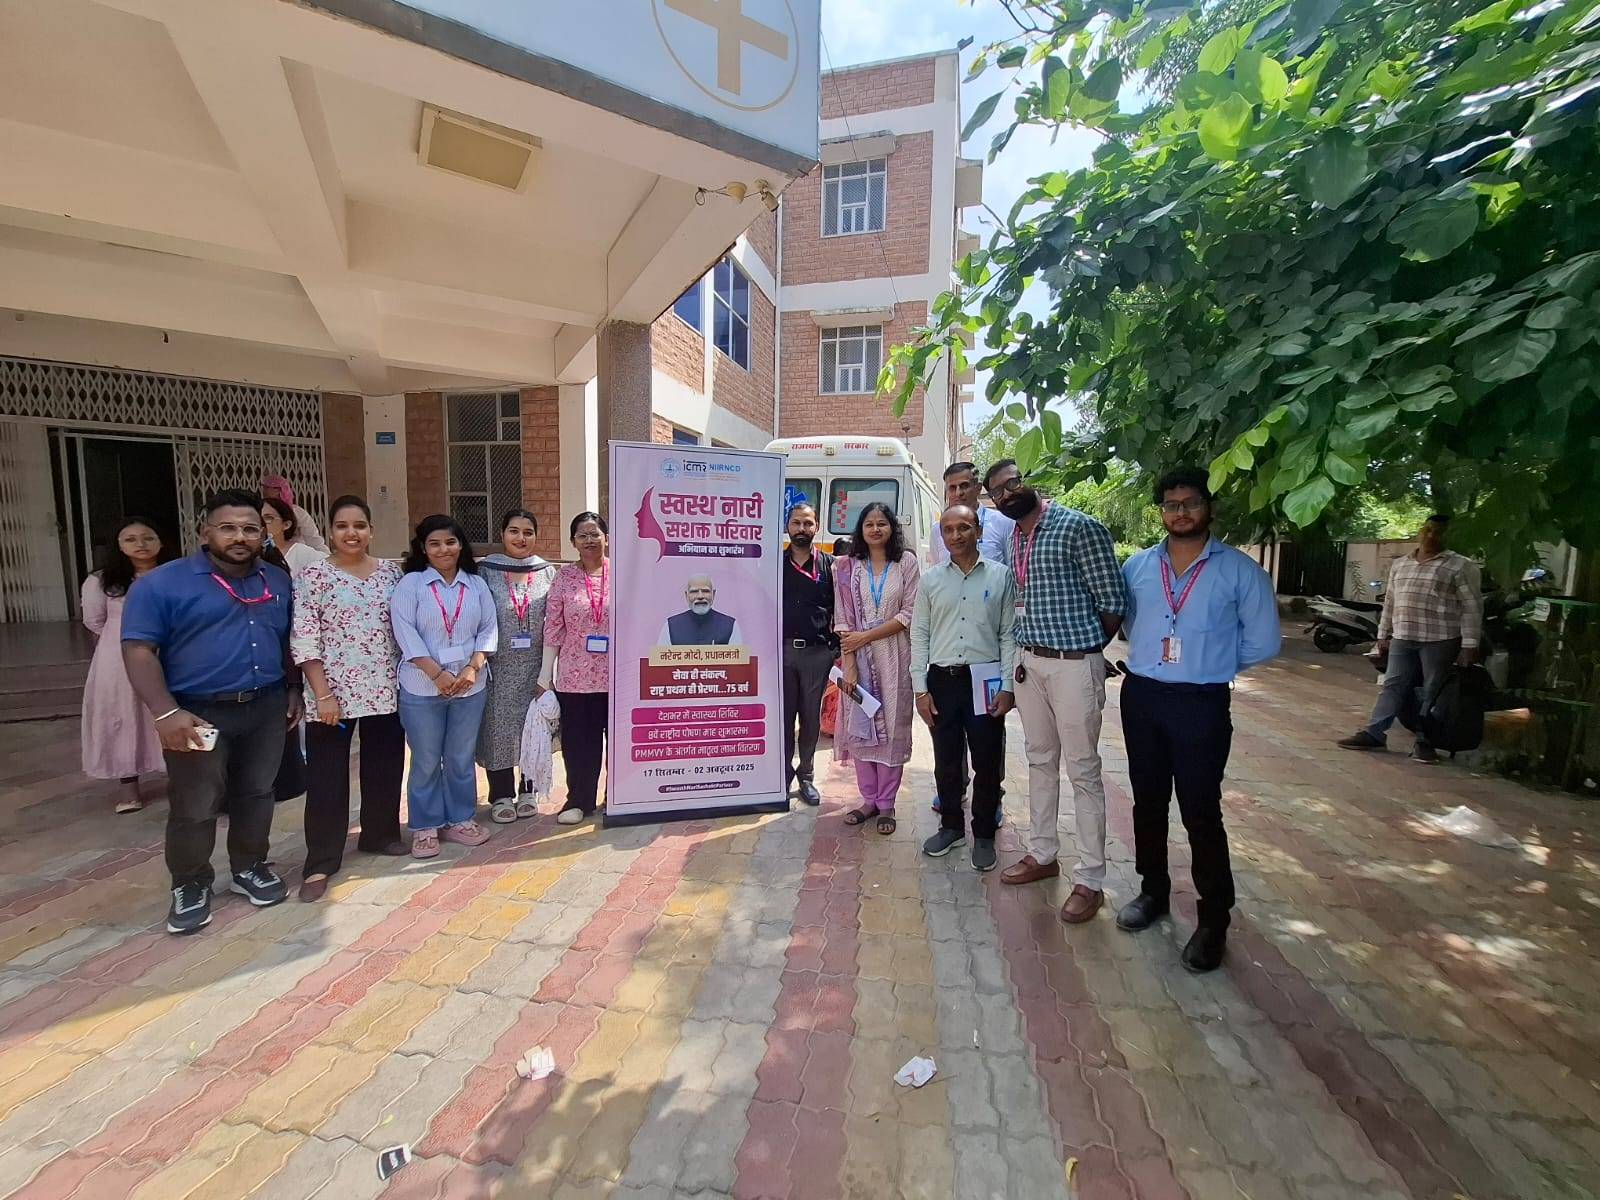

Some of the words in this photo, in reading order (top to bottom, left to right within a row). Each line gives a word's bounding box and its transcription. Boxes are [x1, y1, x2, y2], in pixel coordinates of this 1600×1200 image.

[709, 463, 741, 472] NIIRNCD
[658, 493, 717, 517] स्वस्थ
[720, 492, 764, 518] नारी
[665, 521, 711, 539] सशक्त
[714, 519, 763, 540] परिवार
[678, 543, 707, 554] अभियान
[708, 545, 717, 554] का
[718, 545, 744, 556] शुभारंभ
[660, 649, 681, 660] नरेन्द्र
[684, 648, 703, 661] मोदी,
[704, 648, 740, 660] प्रधानमंत्री
[672, 669, 689, 680] सेवा
[690, 668, 699, 680] ही
[700, 668, 728, 680] संकल्प,
[666, 685, 686, 695] प्रथम
[688, 682, 697, 694] ही
[738, 681, 749, 693] वर्ष
[658, 711, 681, 721] देशभर
[718, 707, 739, 718] शिविर
[682, 727, 701, 738] पोषण
[702, 727, 716, 737] माह
[635, 748, 664, 759] PMMVY
[643, 769, 653, 777] 17
[694, 766, 703, 774] 02
[736, 763, 755, 772] 2025
